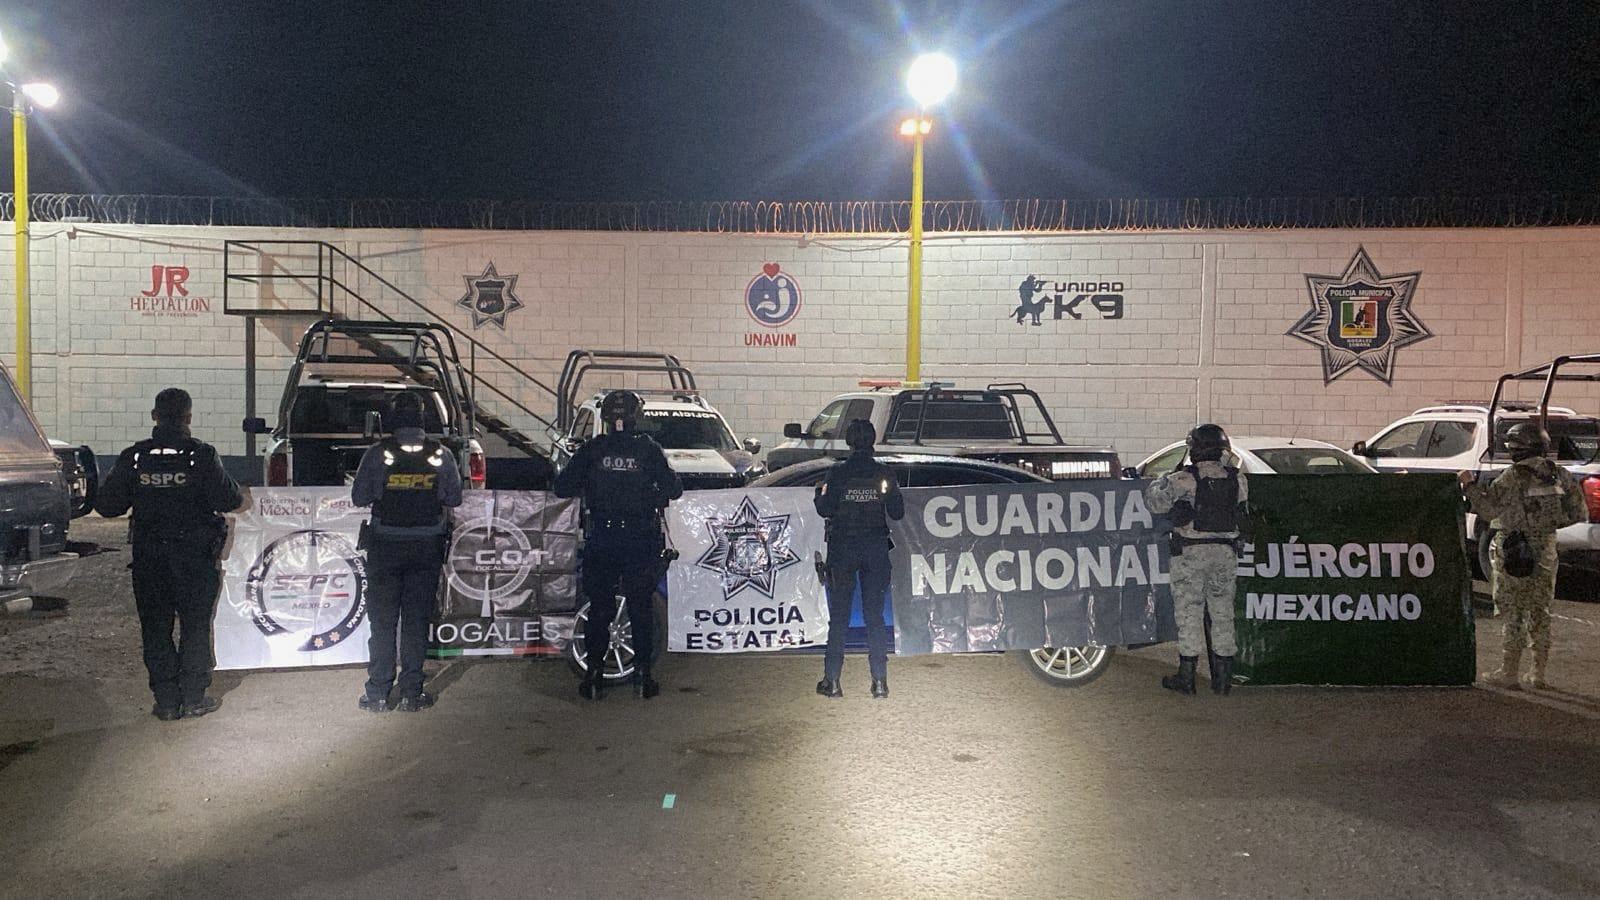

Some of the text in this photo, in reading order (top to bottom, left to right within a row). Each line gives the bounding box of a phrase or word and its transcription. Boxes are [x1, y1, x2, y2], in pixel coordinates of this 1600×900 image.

[141, 265, 190, 297] JR
[1054, 282, 1124, 293] UNIDAD
[1358, 289, 1393, 297] MUNICIPAL
[130, 297, 210, 312] HEPTATLON
[1054, 294, 1124, 320] K9
[744, 333, 797, 346] UNAVIM
[603, 457, 637, 468] G.O.T.
[1052, 461, 1111, 479] MUNICIPAL
[140, 472, 186, 485] SSPC
[387, 474, 436, 489] SSPC
[260, 503, 311, 516] México
[923, 490, 1153, 538] GUARDIA
[475, 549, 554, 565] G.O.T.
[1236, 535, 1435, 578] EJÉRCITO
[911, 543, 1170, 596] NACIONAL
[694, 602, 804, 627] POLICÍA
[1246, 592, 1422, 621] MEXICANO
[686, 628, 813, 650] ESTATAL
